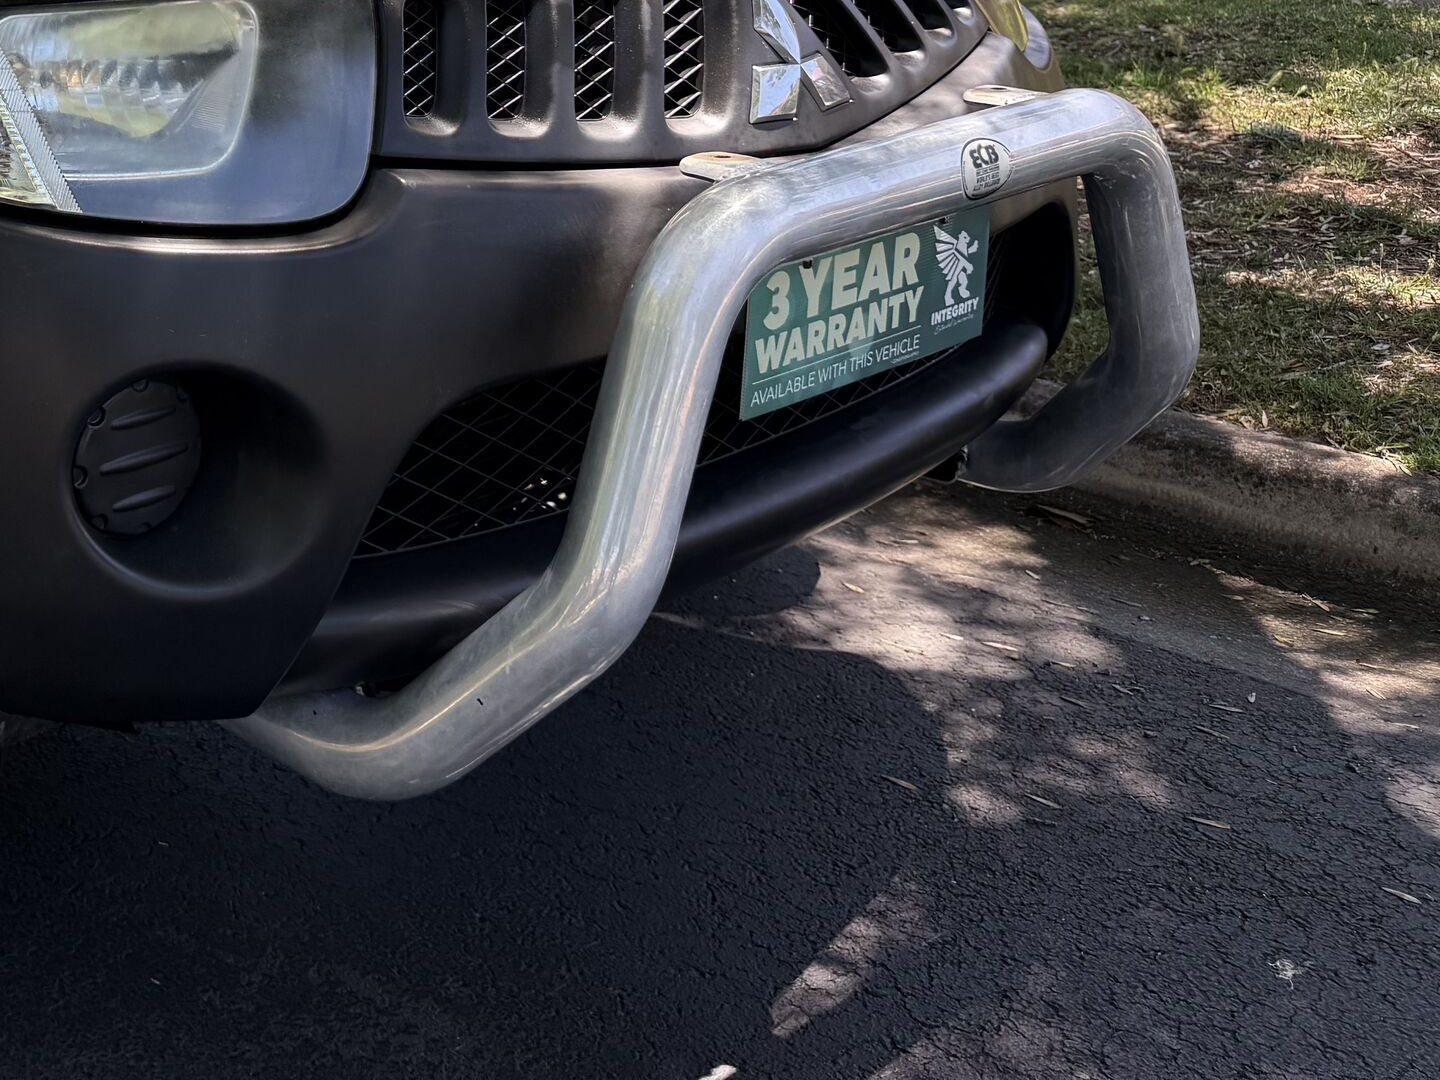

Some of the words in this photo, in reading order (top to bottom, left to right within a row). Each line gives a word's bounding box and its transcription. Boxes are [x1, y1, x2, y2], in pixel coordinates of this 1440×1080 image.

[969, 144, 999, 169] ECB
[763, 270, 791, 331] 3
[799, 232, 921, 318] YEAR
[931, 297, 979, 326] INTEGRITY
[755, 285, 925, 374] WARRANTY
[750, 372, 816, 407] AVAILABLE
[817, 359, 847, 384] WITH
[848, 350, 873, 375] THIS
[874, 334, 921, 367] VEHICLE
